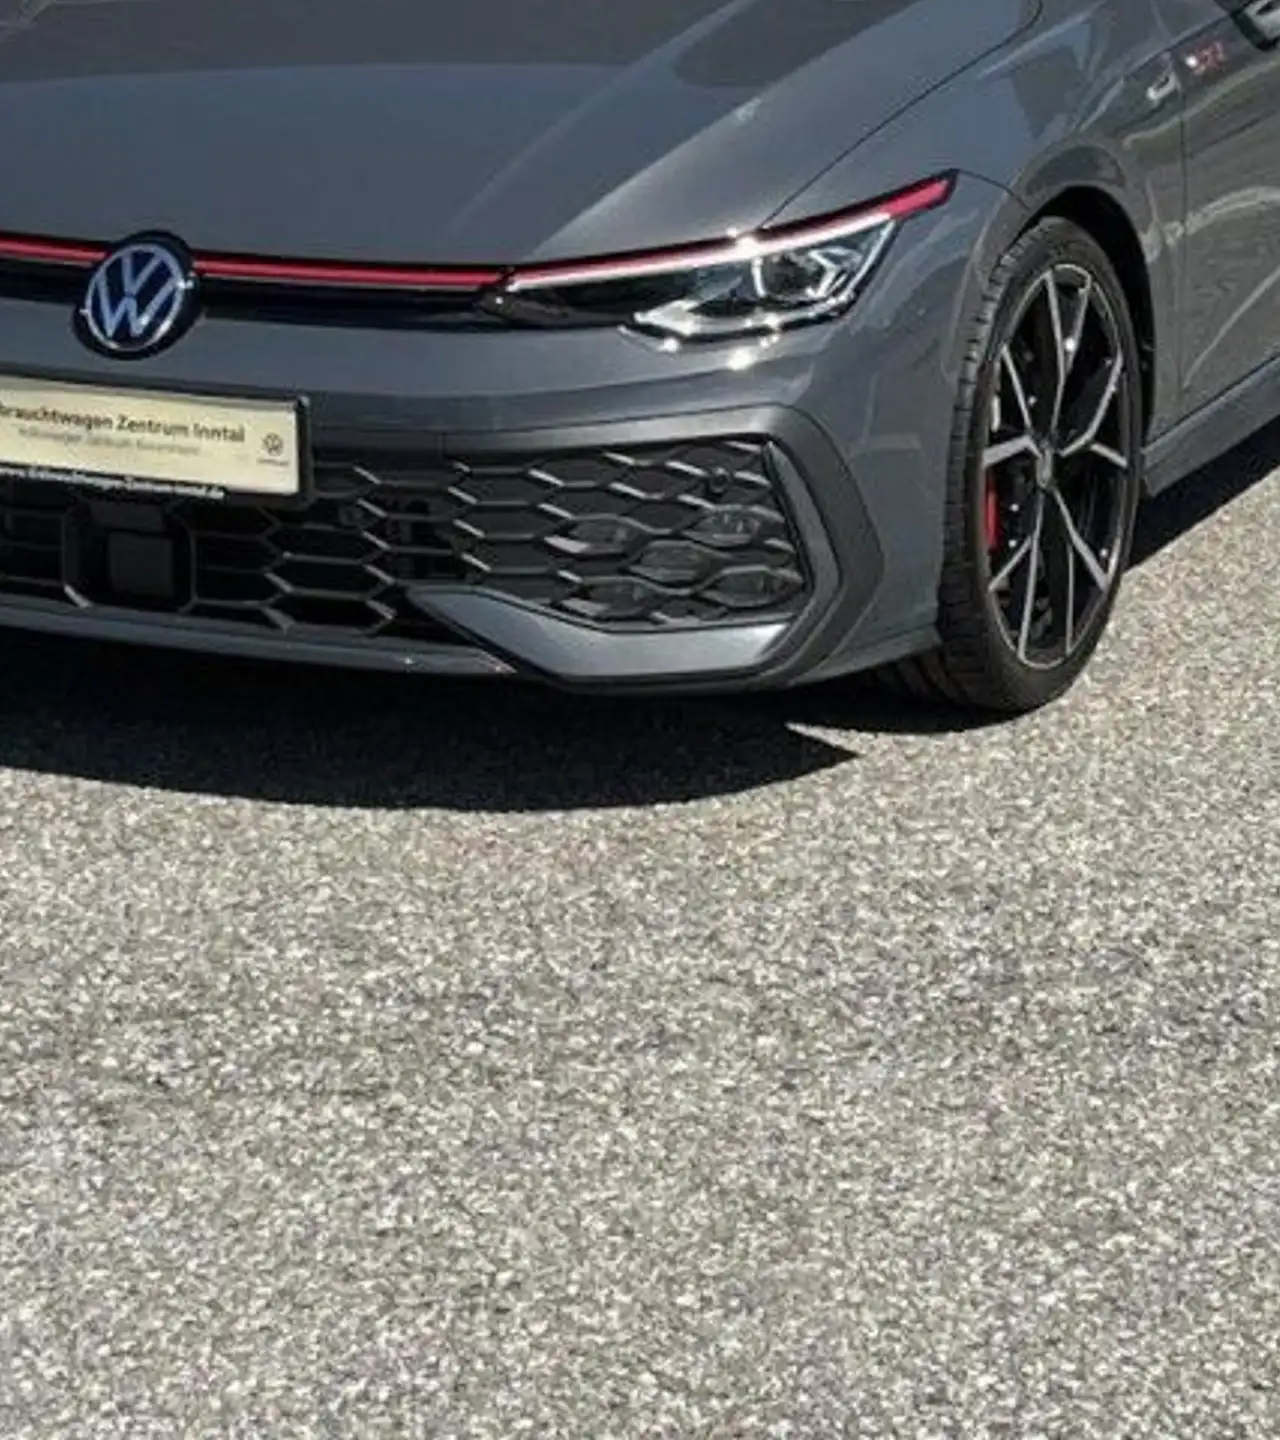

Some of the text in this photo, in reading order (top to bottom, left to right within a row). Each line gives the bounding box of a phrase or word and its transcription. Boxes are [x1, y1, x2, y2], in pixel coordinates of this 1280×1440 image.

[84, 242, 186, 351] VW
[118, 413, 188, 438] Zentrum
[193, 422, 246, 443] Inntal
